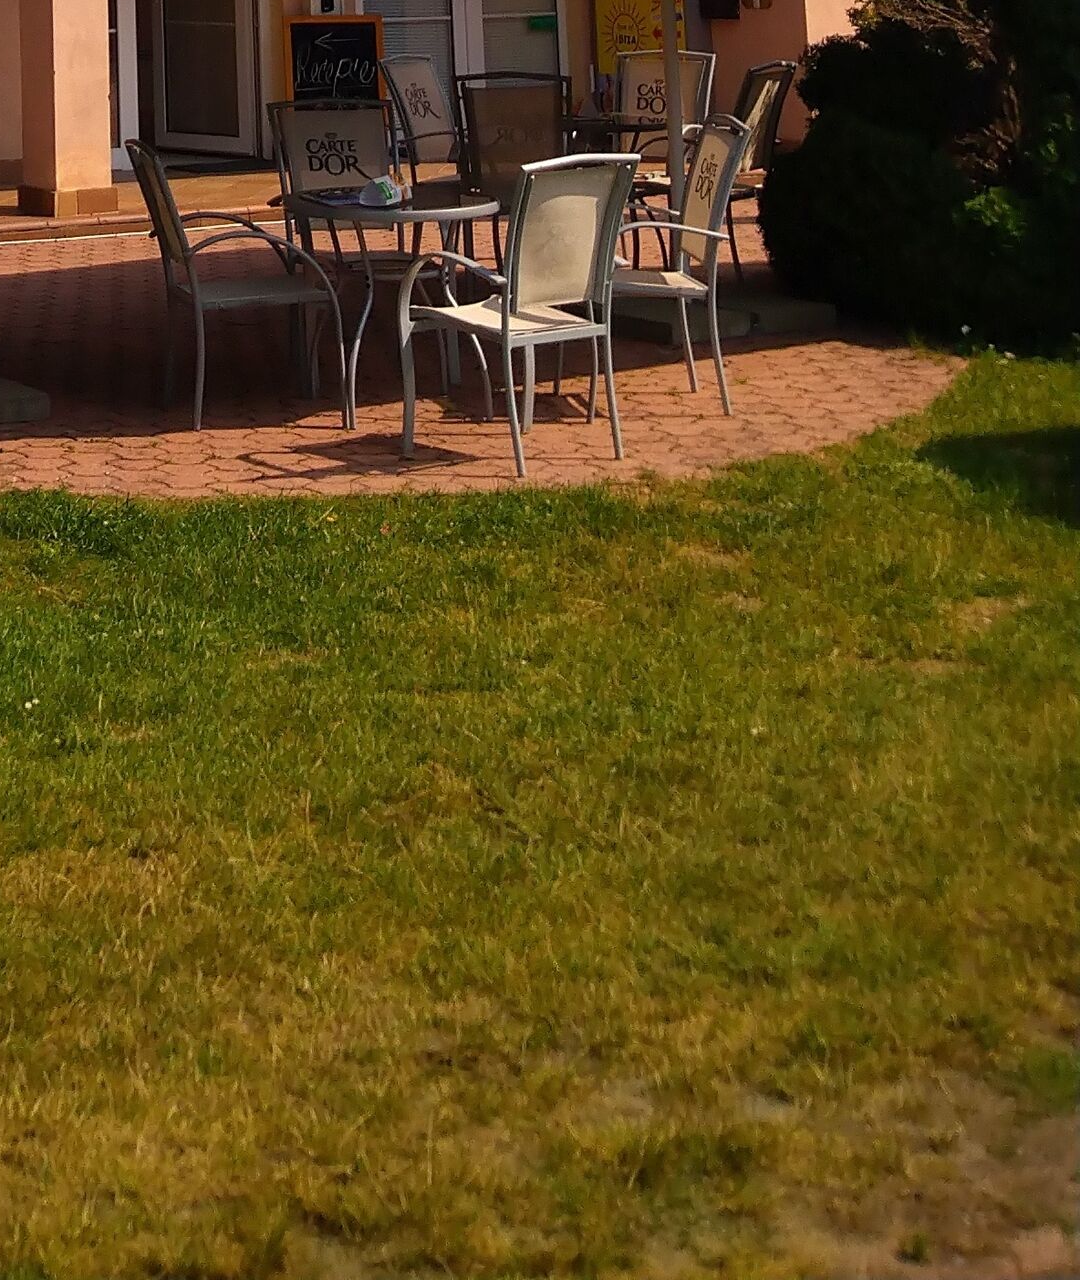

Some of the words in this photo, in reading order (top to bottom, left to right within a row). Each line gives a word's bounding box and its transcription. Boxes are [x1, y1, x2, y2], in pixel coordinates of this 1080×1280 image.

[405, 86, 428, 100] CARTE
[409, 100, 441, 119] D'OR
[637, 96, 667, 115] D'O
[305, 139, 357, 154] CARTE
[308, 152, 372, 180] D'OR
[700, 157, 719, 178] CARTE
[695, 176, 715, 208] D'OR
